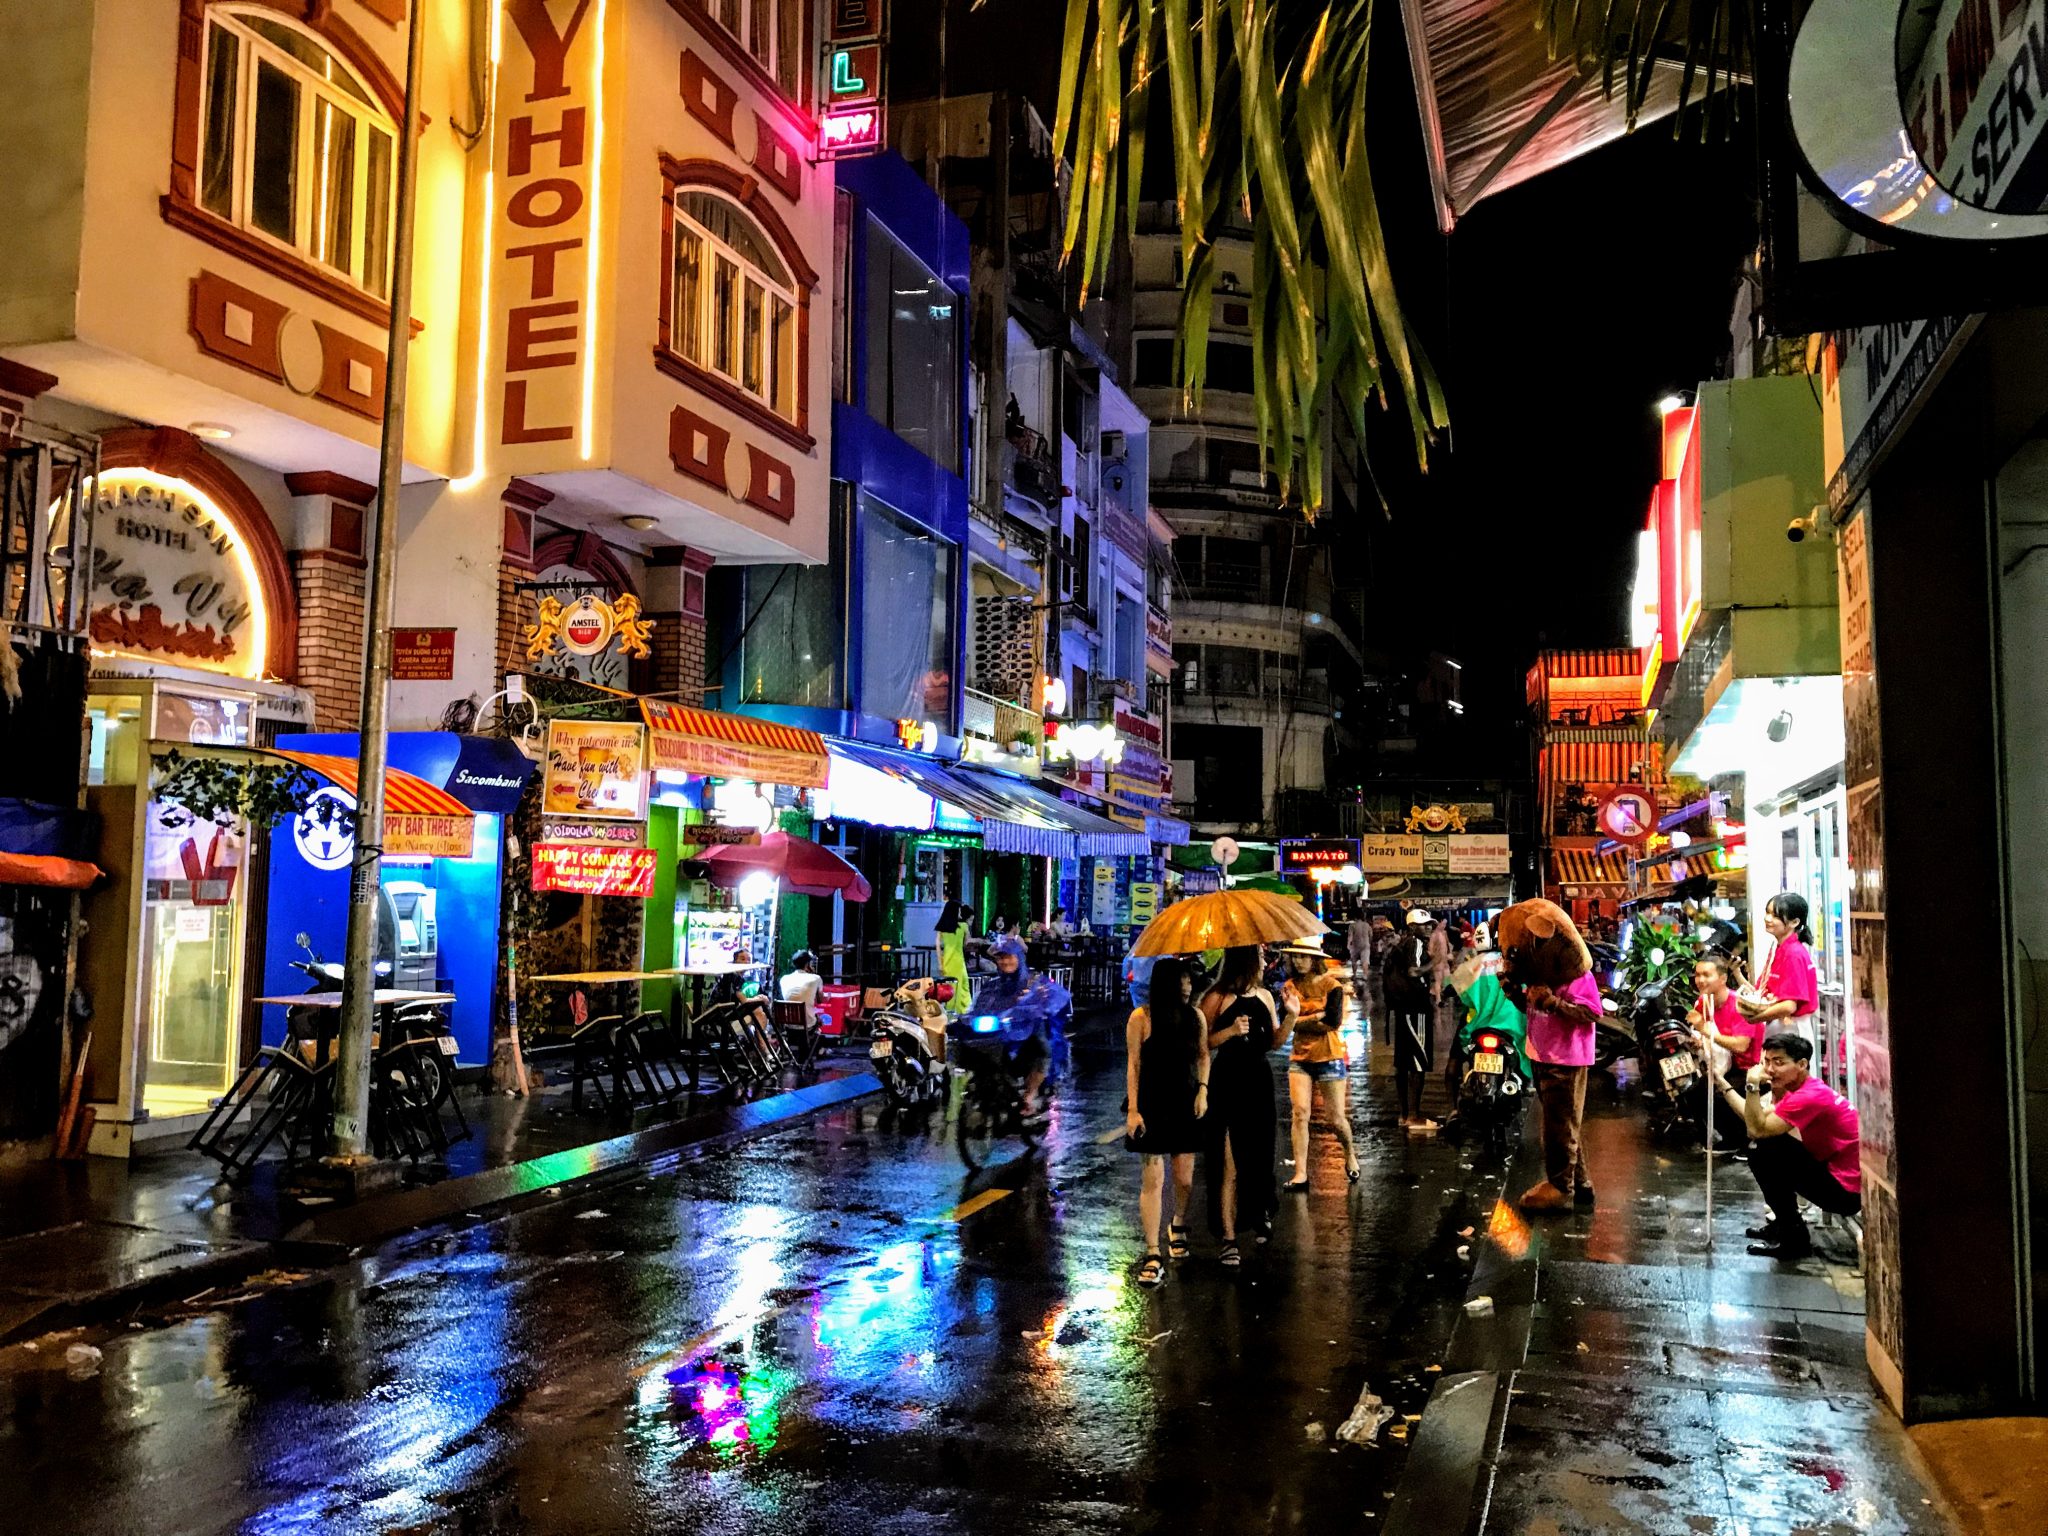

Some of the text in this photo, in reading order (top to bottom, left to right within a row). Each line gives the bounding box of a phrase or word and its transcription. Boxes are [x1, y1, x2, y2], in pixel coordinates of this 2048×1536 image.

[501, 106, 587, 445] HOTEL
[115, 516, 196, 551] HOTEL
[571, 618, 600, 627] AMSTEL
[1847, 600, 1867, 645] RENT
[555, 731, 574, 746] Why
[577, 735, 592, 746] not
[594, 738, 618, 747] come
[553, 753, 620, 779] Have fun with
[455, 768, 523, 788] Sacombank
[405, 817, 424, 836] BAR
[426, 818, 455, 837] THREE
[1649, 832, 1670, 850] ger
[538, 849, 579, 864] HAPPY
[1292, 852, 1314, 862] BẠN
[1367, 846, 1420, 857] Crazy Tour
